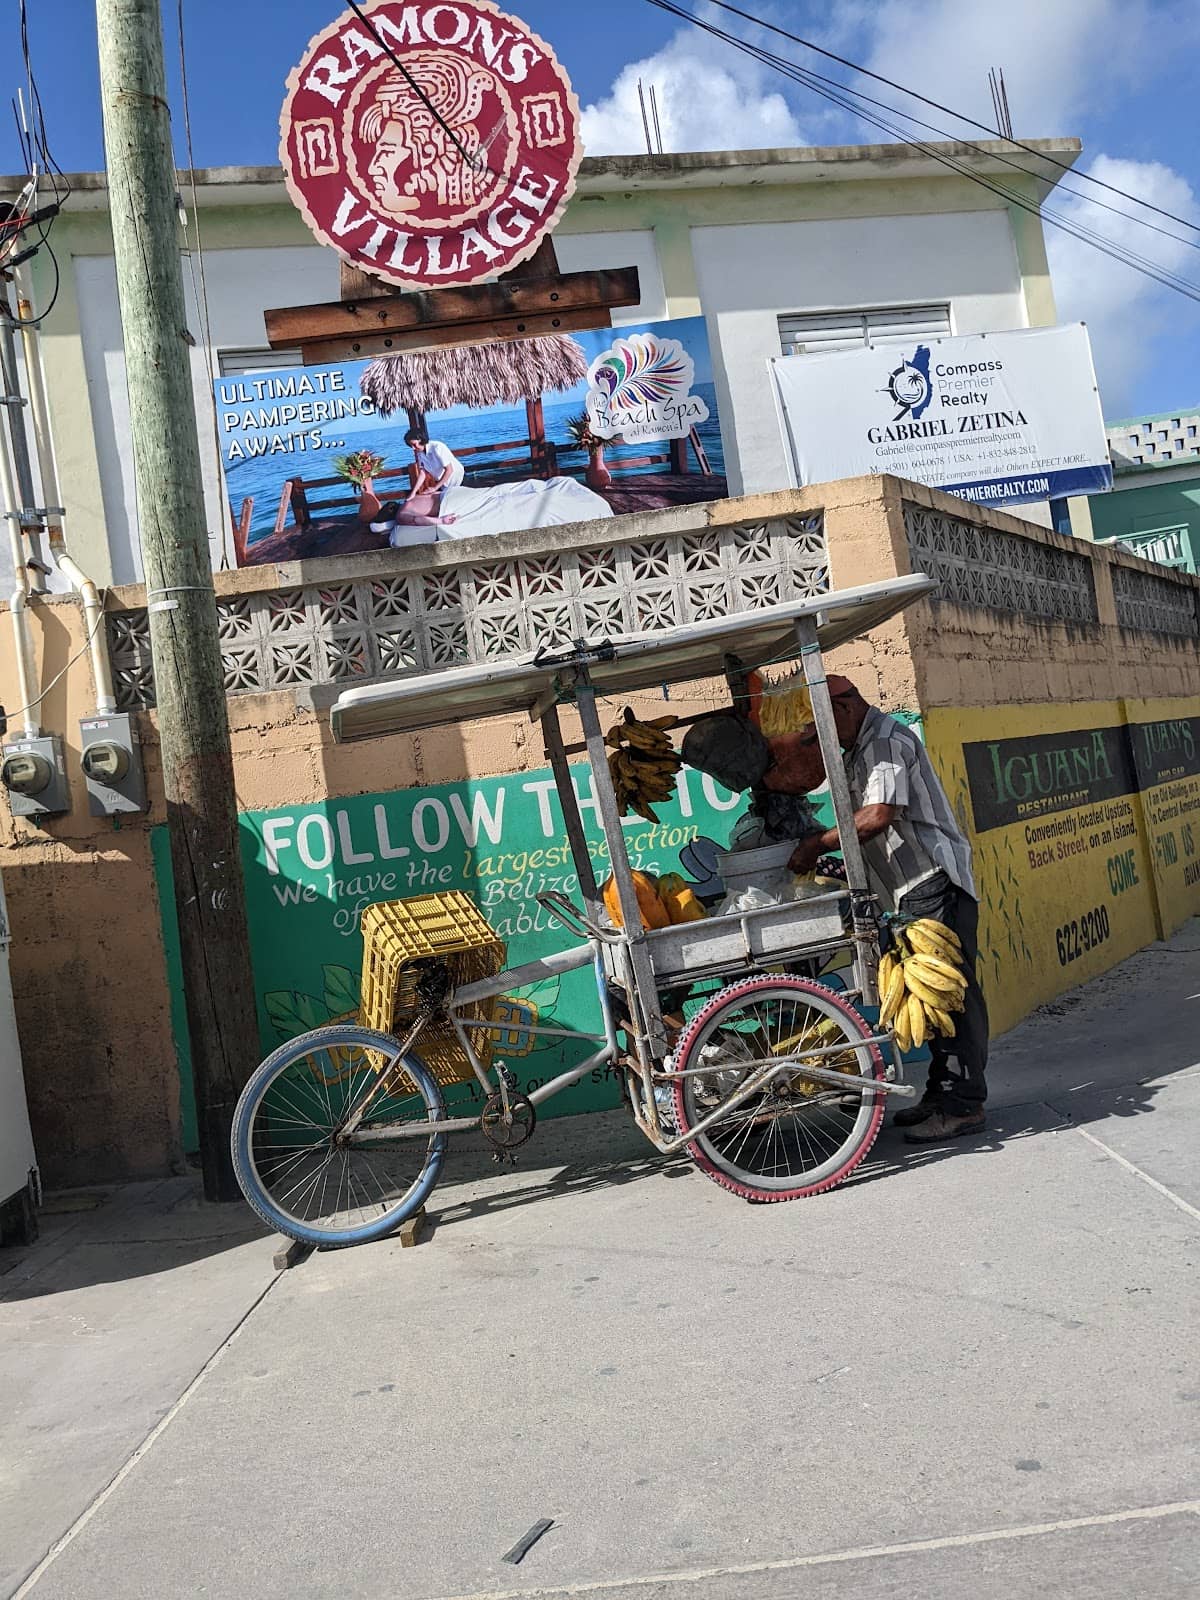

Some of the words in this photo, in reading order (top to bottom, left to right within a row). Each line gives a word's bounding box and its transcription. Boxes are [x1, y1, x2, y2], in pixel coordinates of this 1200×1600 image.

[304, 5, 542, 108] RAMON'S
[332, 166, 560, 276] VILLAGE
[935, 358, 1003, 377] Compass
[938, 375, 996, 392] Premier
[220, 371, 345, 404] ULTIMATE
[941, 391, 988, 408] Realty
[223, 395, 377, 432] PAMPERING
[596, 399, 658, 429] Beach
[663, 397, 702, 430] Spa
[867, 419, 954, 444] GABRIEL
[958, 410, 1029, 433] ZETINA
[228, 430, 345, 460] AWAITS...
[987, 731, 1114, 804] IGUANA
[1016, 788, 1090, 815] RESTAURANT
[262, 786, 506, 876] FOLLOW
[1025, 815, 1077, 846] Conveniently
[1078, 807, 1104, 829] located
[272, 878, 319, 907] We
[325, 872, 399, 900] have
[405, 859, 453, 888] the
[463, 833, 572, 884] largest
[585, 822, 700, 861] seection
[1027, 845, 1056, 870] Back
[1056, 835, 1089, 861] Street,
[1089, 833, 1101, 850] on
[1101, 829, 1112, 846] an
[1106, 848, 1140, 896] COME
[333, 897, 370, 937] of
[480, 871, 578, 907] Belize
[1055, 904, 1110, 967] 622-9200
